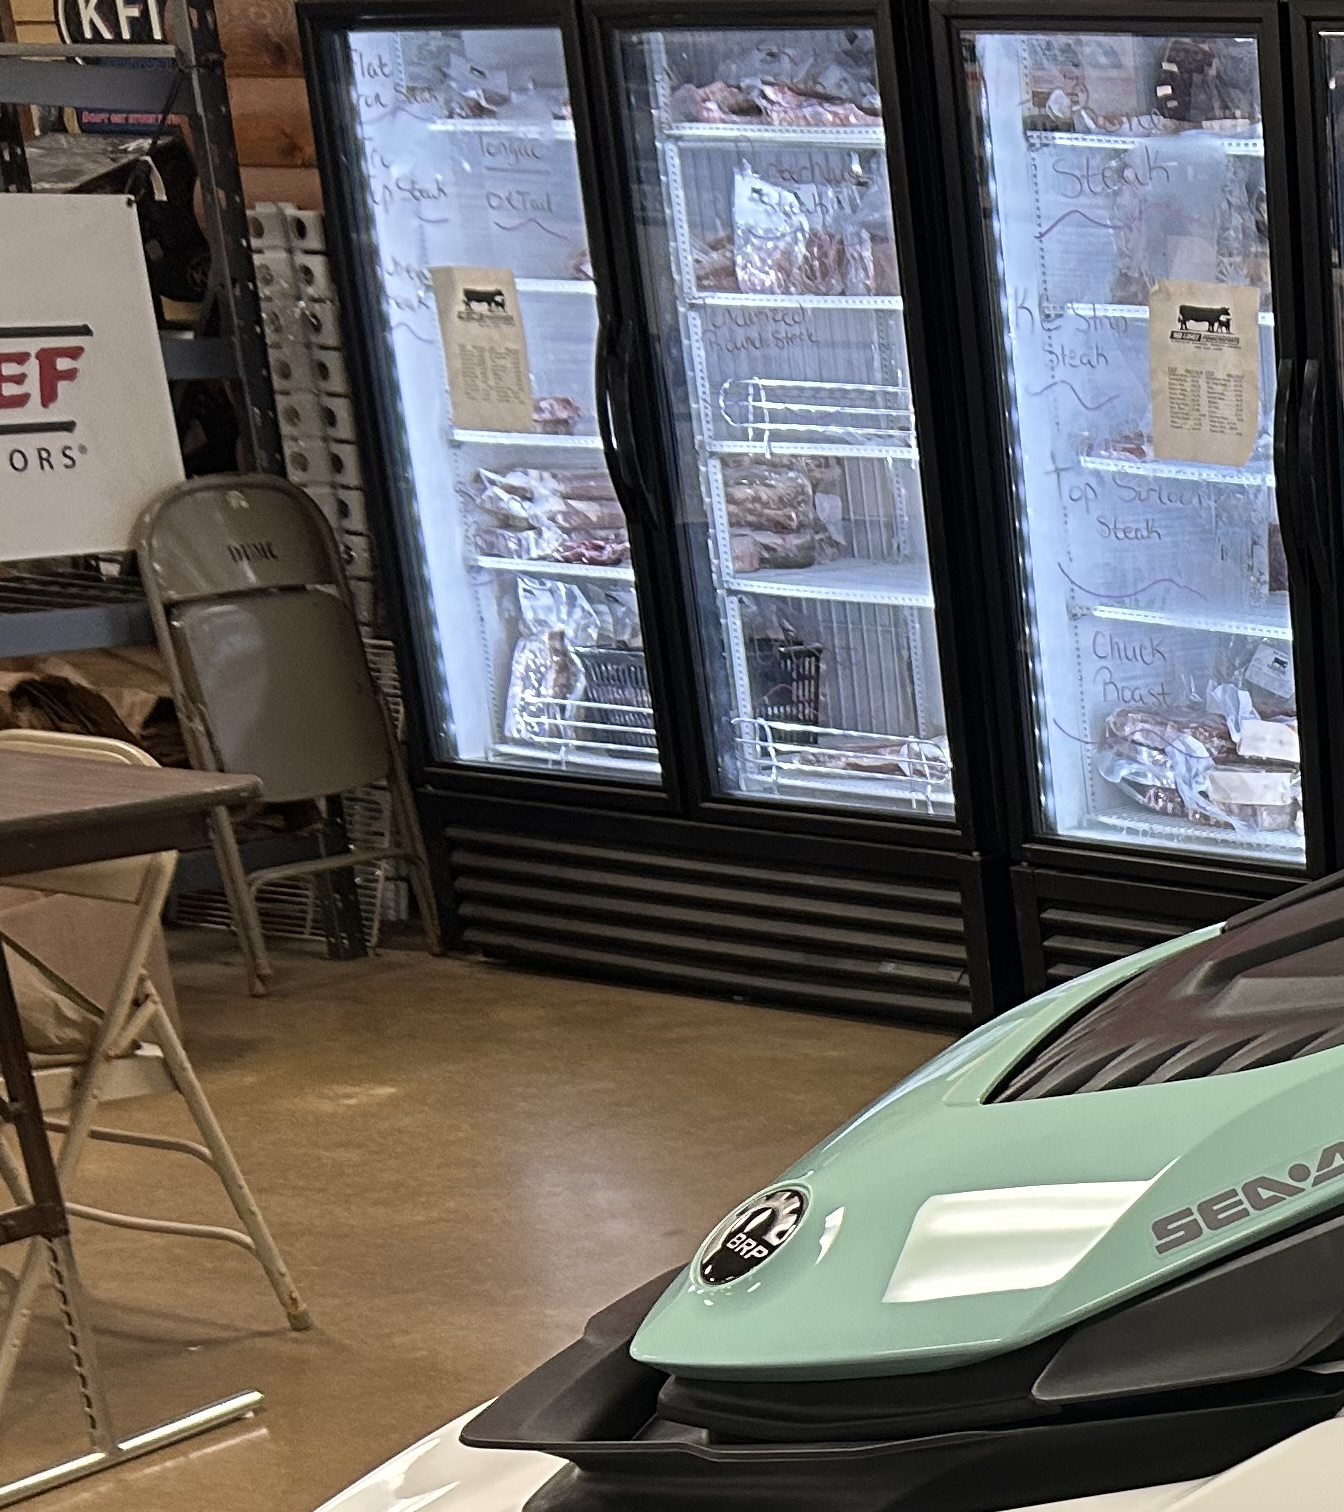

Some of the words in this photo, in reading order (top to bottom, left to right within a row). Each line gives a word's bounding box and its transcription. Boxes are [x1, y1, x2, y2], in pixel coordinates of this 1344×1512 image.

[1092, 630, 1167, 666] Chuck
[1093, 665, 1172, 708] Roast
[726, 1232, 769, 1259] BRP
